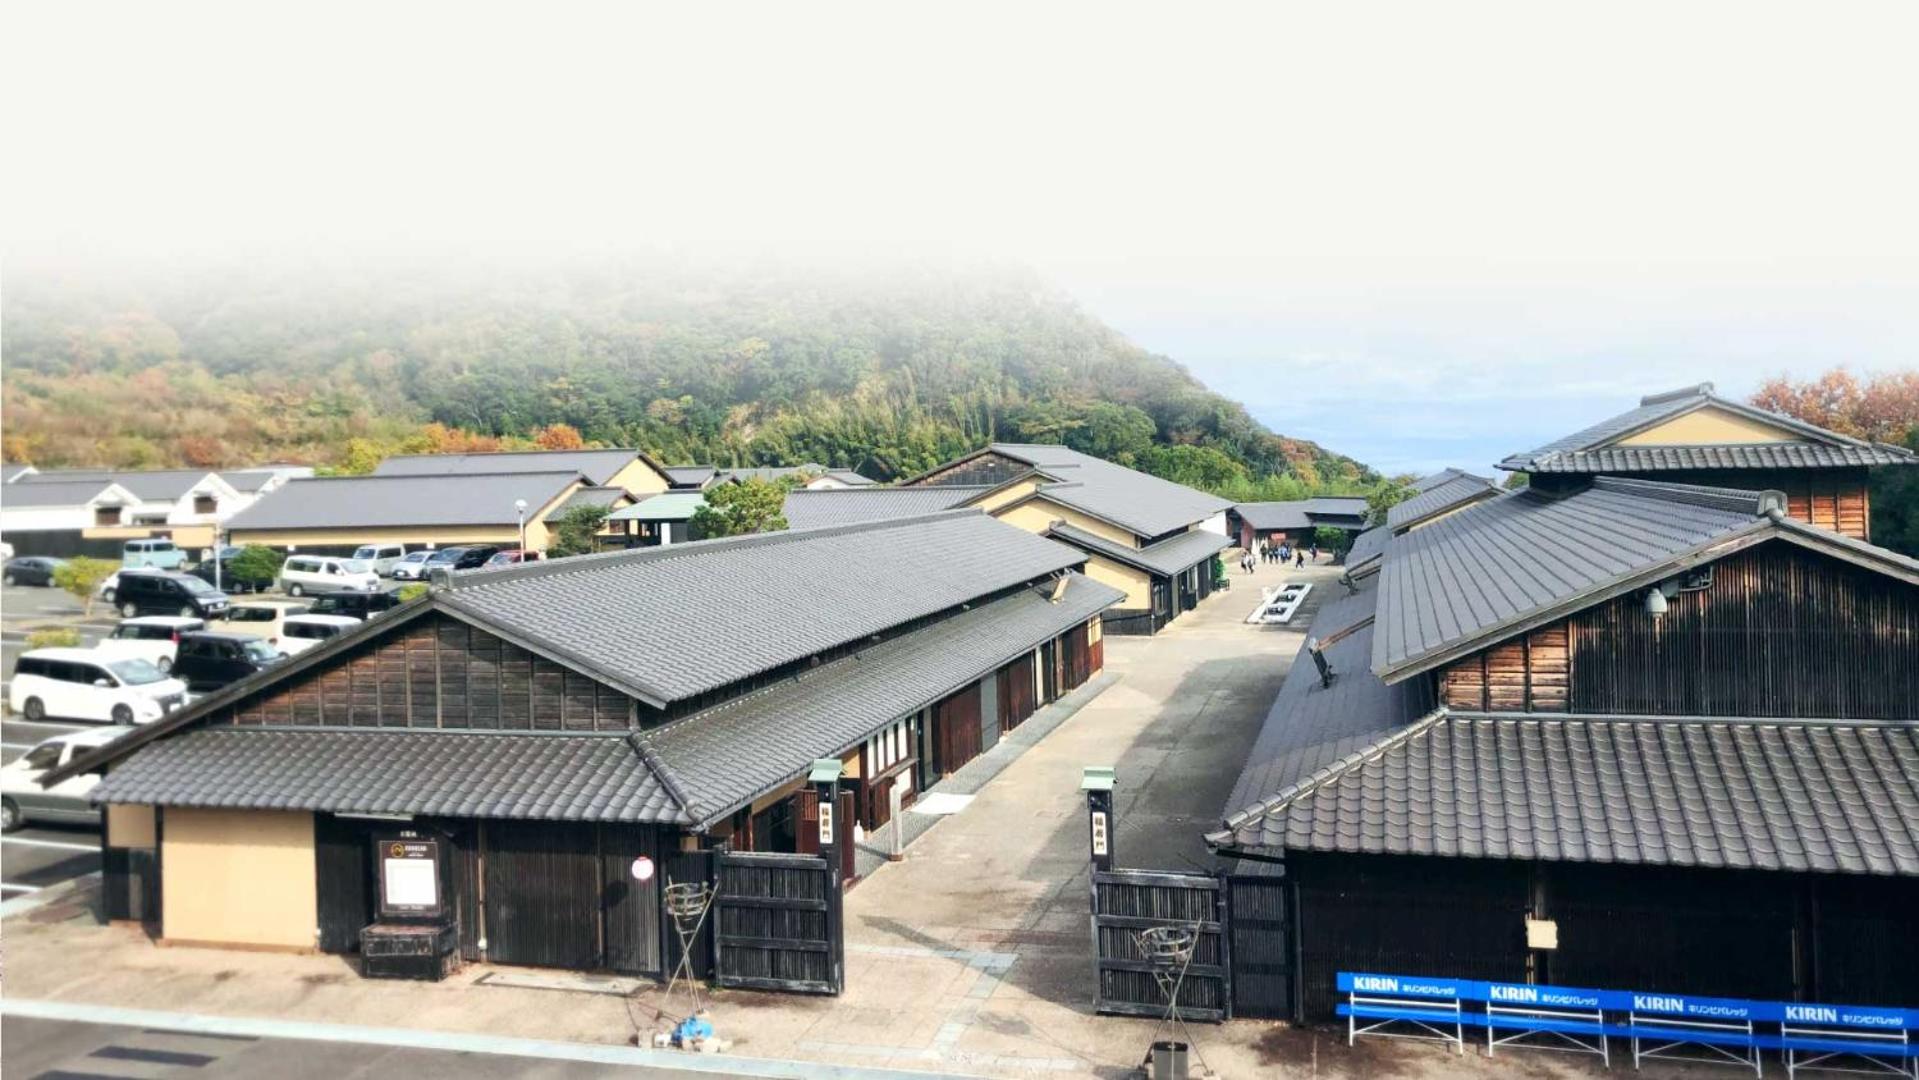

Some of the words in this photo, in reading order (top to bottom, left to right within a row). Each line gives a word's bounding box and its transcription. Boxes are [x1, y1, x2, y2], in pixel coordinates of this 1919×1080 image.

[1354, 976, 1398, 991] KIRIN
[1490, 985, 1537, 1001] KIRIN
[1634, 995, 1683, 1011] KIRIN
[1785, 1005, 1837, 1022] KIRIN
